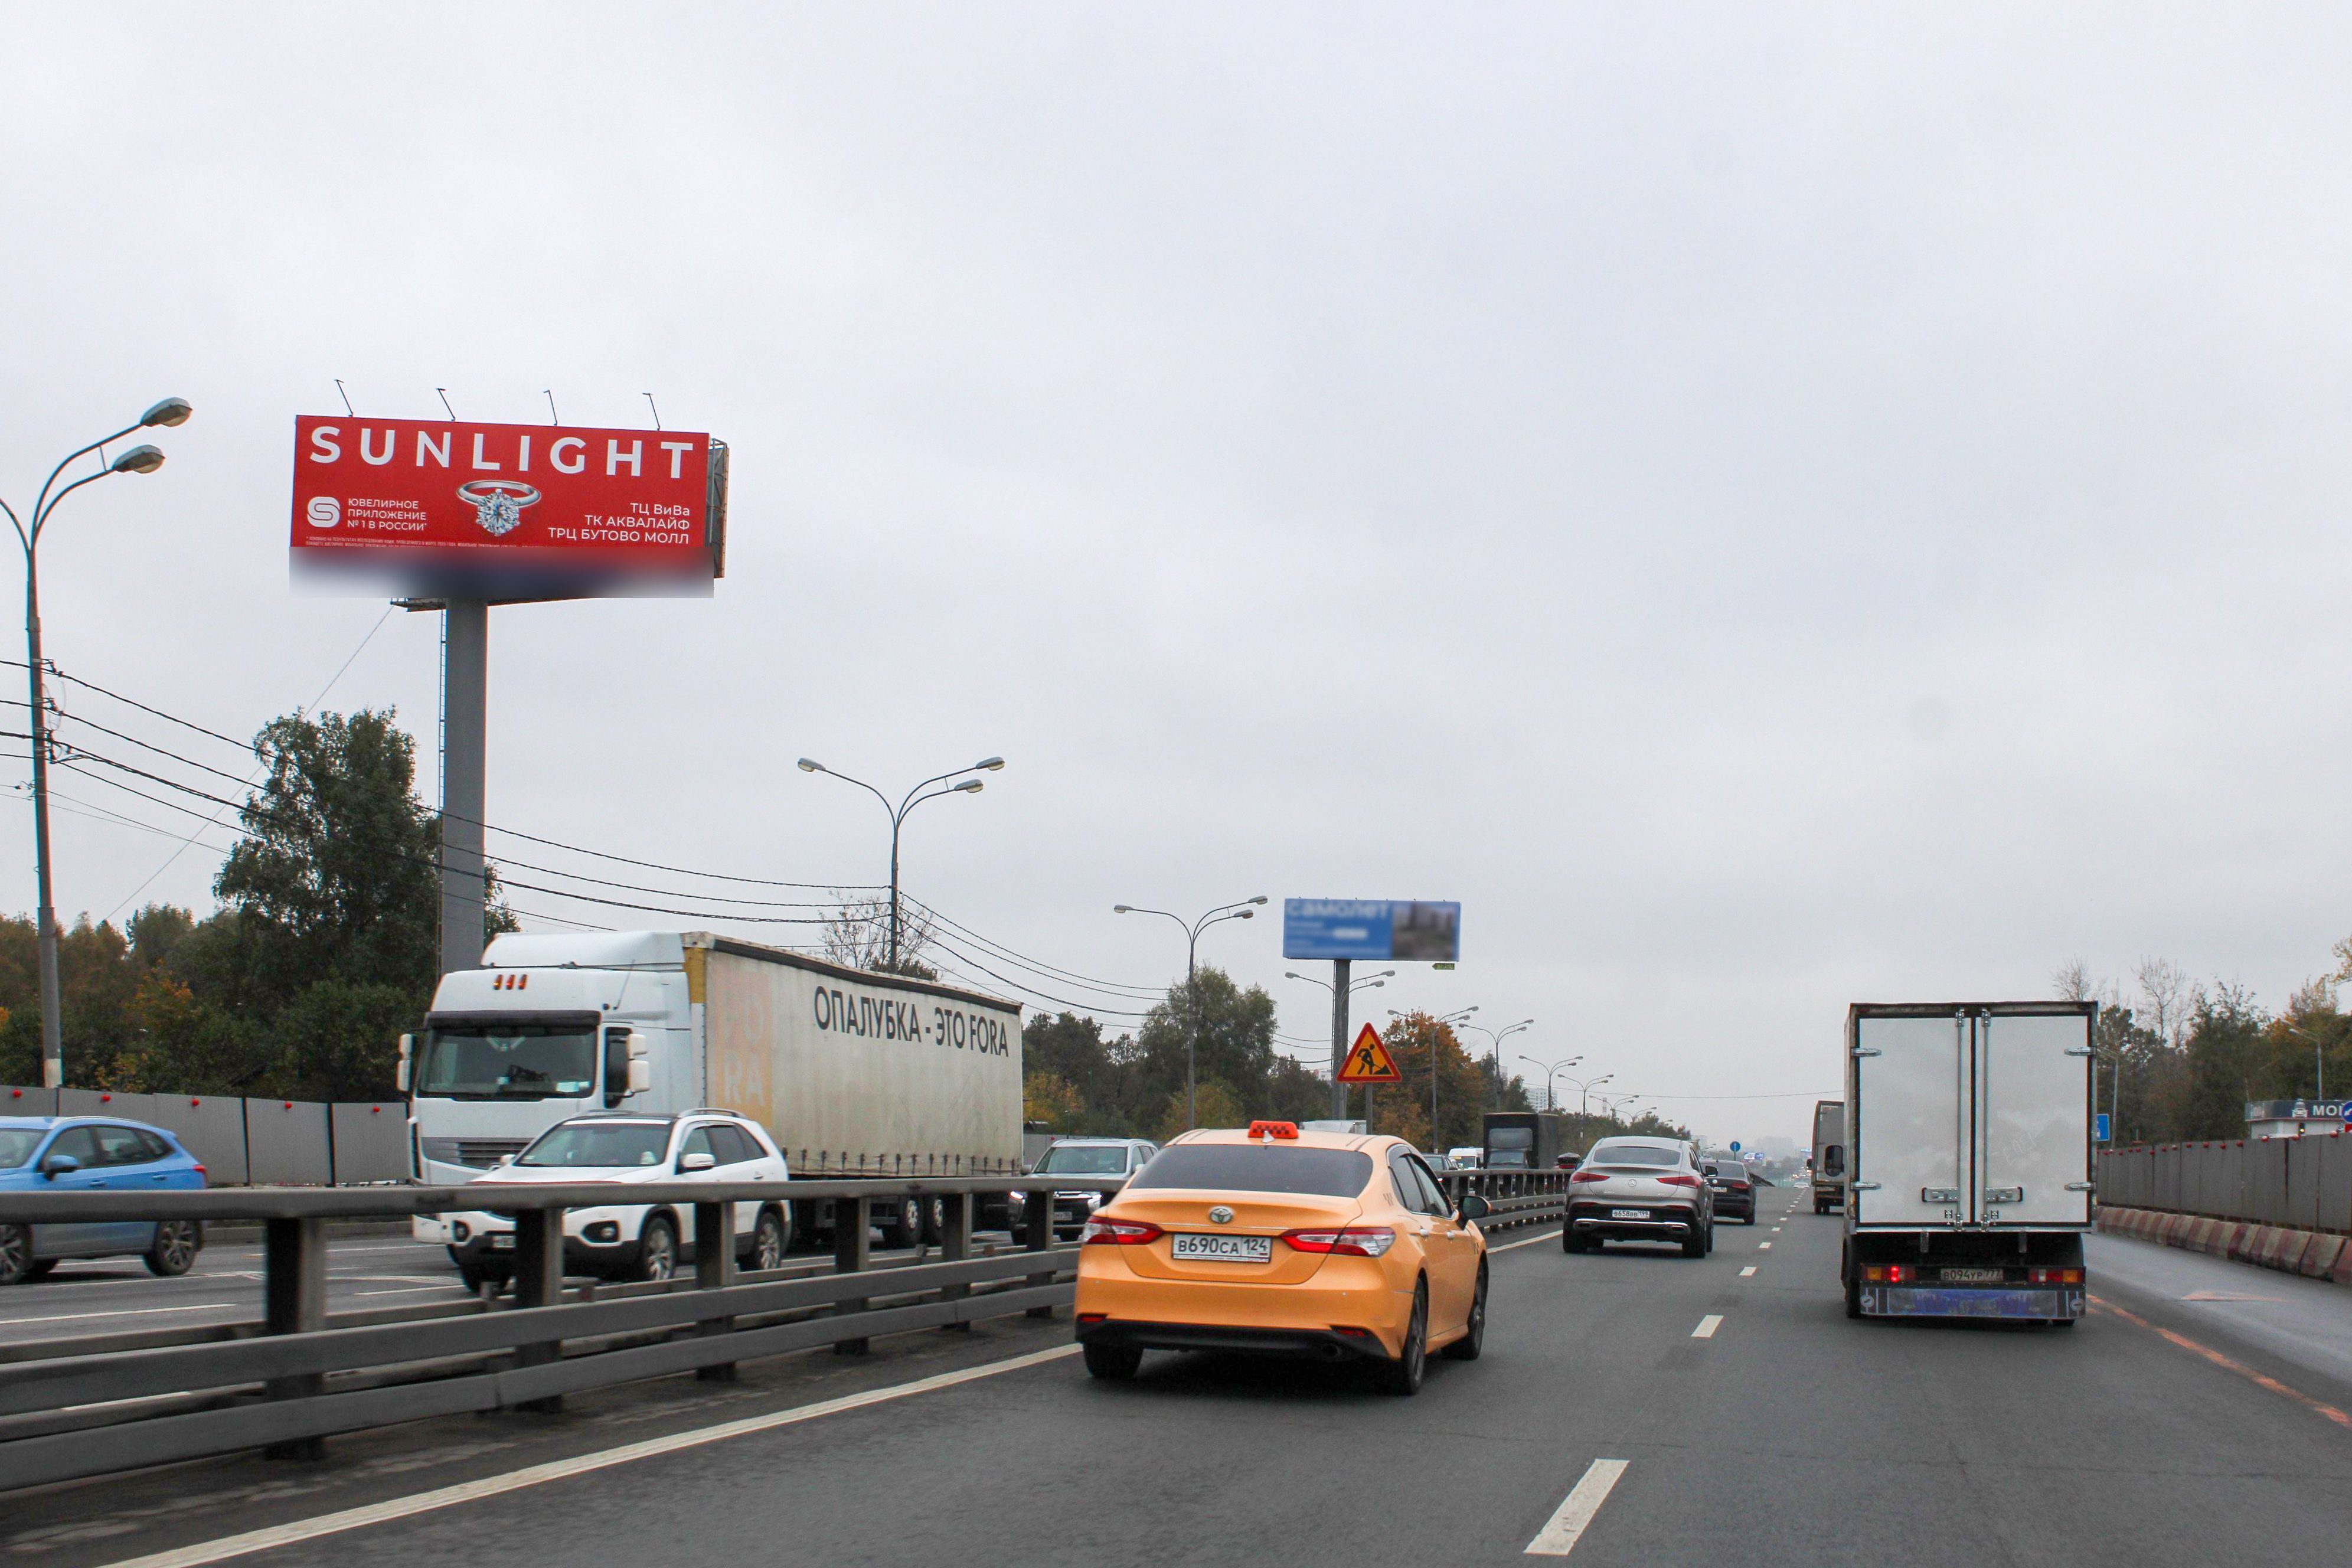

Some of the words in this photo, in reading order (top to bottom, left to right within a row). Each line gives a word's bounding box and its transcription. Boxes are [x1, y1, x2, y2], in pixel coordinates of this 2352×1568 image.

[310, 426, 694, 479] SUNLIGHT
[348, 498, 419, 509] ЮВЕЛИРНОЕ
[630, 502, 650, 515] ТЦ
[654, 504, 690, 517] ВиВа
[348, 509, 427, 521] ПРИЛОЖЕНИЕ
[368, 521, 376, 529] В
[584, 515, 603, 526] ТК
[606, 517, 690, 531] АКВАЛАЙФ
[548, 527, 577, 541] ТРЦ
[581, 529, 641, 542] БУТОВО
[645, 533, 690, 544] МОЛЛ
[815, 985, 922, 1043] ОПАЛУБКА
[935, 1007, 966, 1049] ЭТО
[970, 1014, 1009, 1057] FORA
[1243, 1239, 1268, 1251] 124
